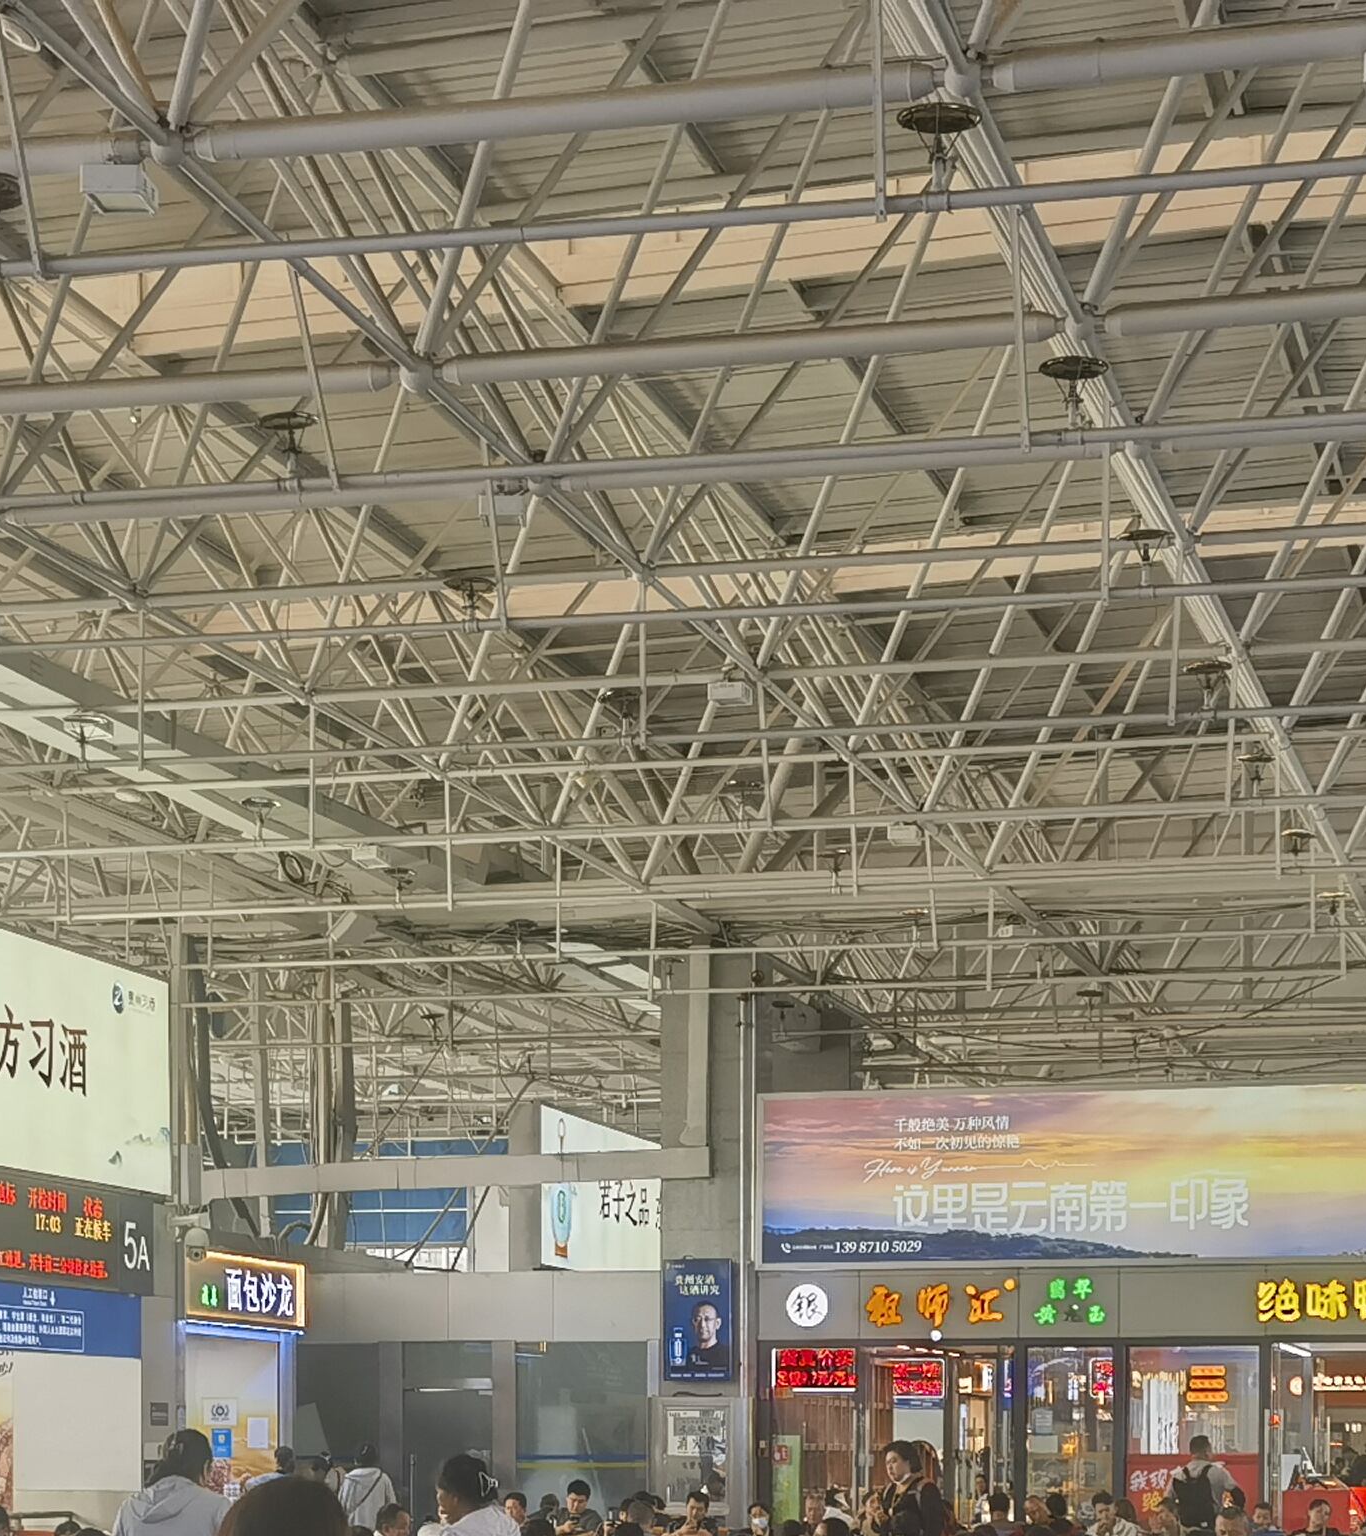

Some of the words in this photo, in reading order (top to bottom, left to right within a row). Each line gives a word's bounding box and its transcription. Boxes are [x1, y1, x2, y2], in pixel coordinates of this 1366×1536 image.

[894, 1117, 948, 1133] 千般绝美
[953, 1116, 1010, 1132] 万种风情
[894, 1134, 1020, 1151] 不如一次初见的惊艳
[83, 1194, 103, 1219] 状态
[892, 1178, 1250, 1234] 这里是云南第一印象
[35, 1212, 62, 1234] 17:03
[74, 1216, 112, 1242] 正在候车
[124, 1220, 151, 1272] 5A
[835, 1241, 857, 1254] 139
[859, 1241, 889, 1254] 8710
[891, 1240, 922, 1253] 5029
[225, 1267, 295, 1317] 面包沙龙
